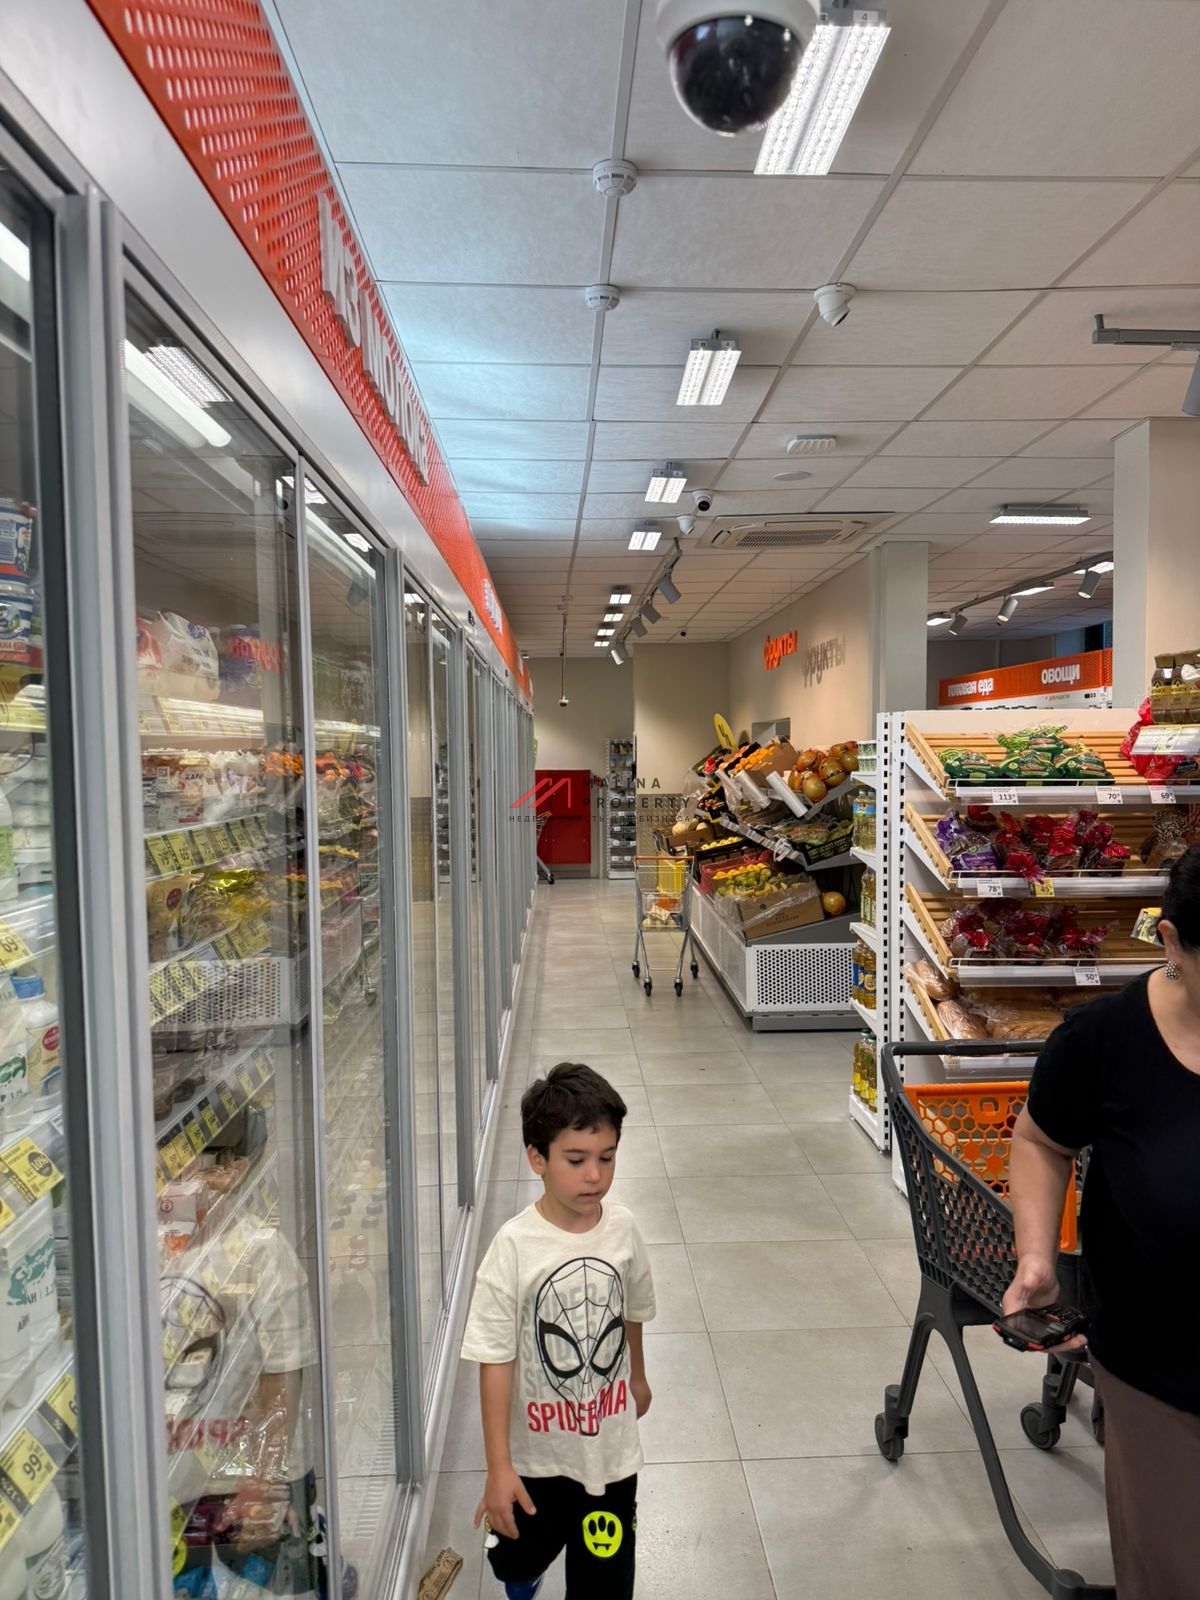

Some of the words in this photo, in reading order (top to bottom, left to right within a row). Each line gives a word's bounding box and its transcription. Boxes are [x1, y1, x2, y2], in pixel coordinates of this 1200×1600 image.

[764, 630, 798, 672] фрукты
[978, 677, 994, 696] еда
[1041, 664, 1080, 685] овощи
[22, 1453, 43, 1481] 99
